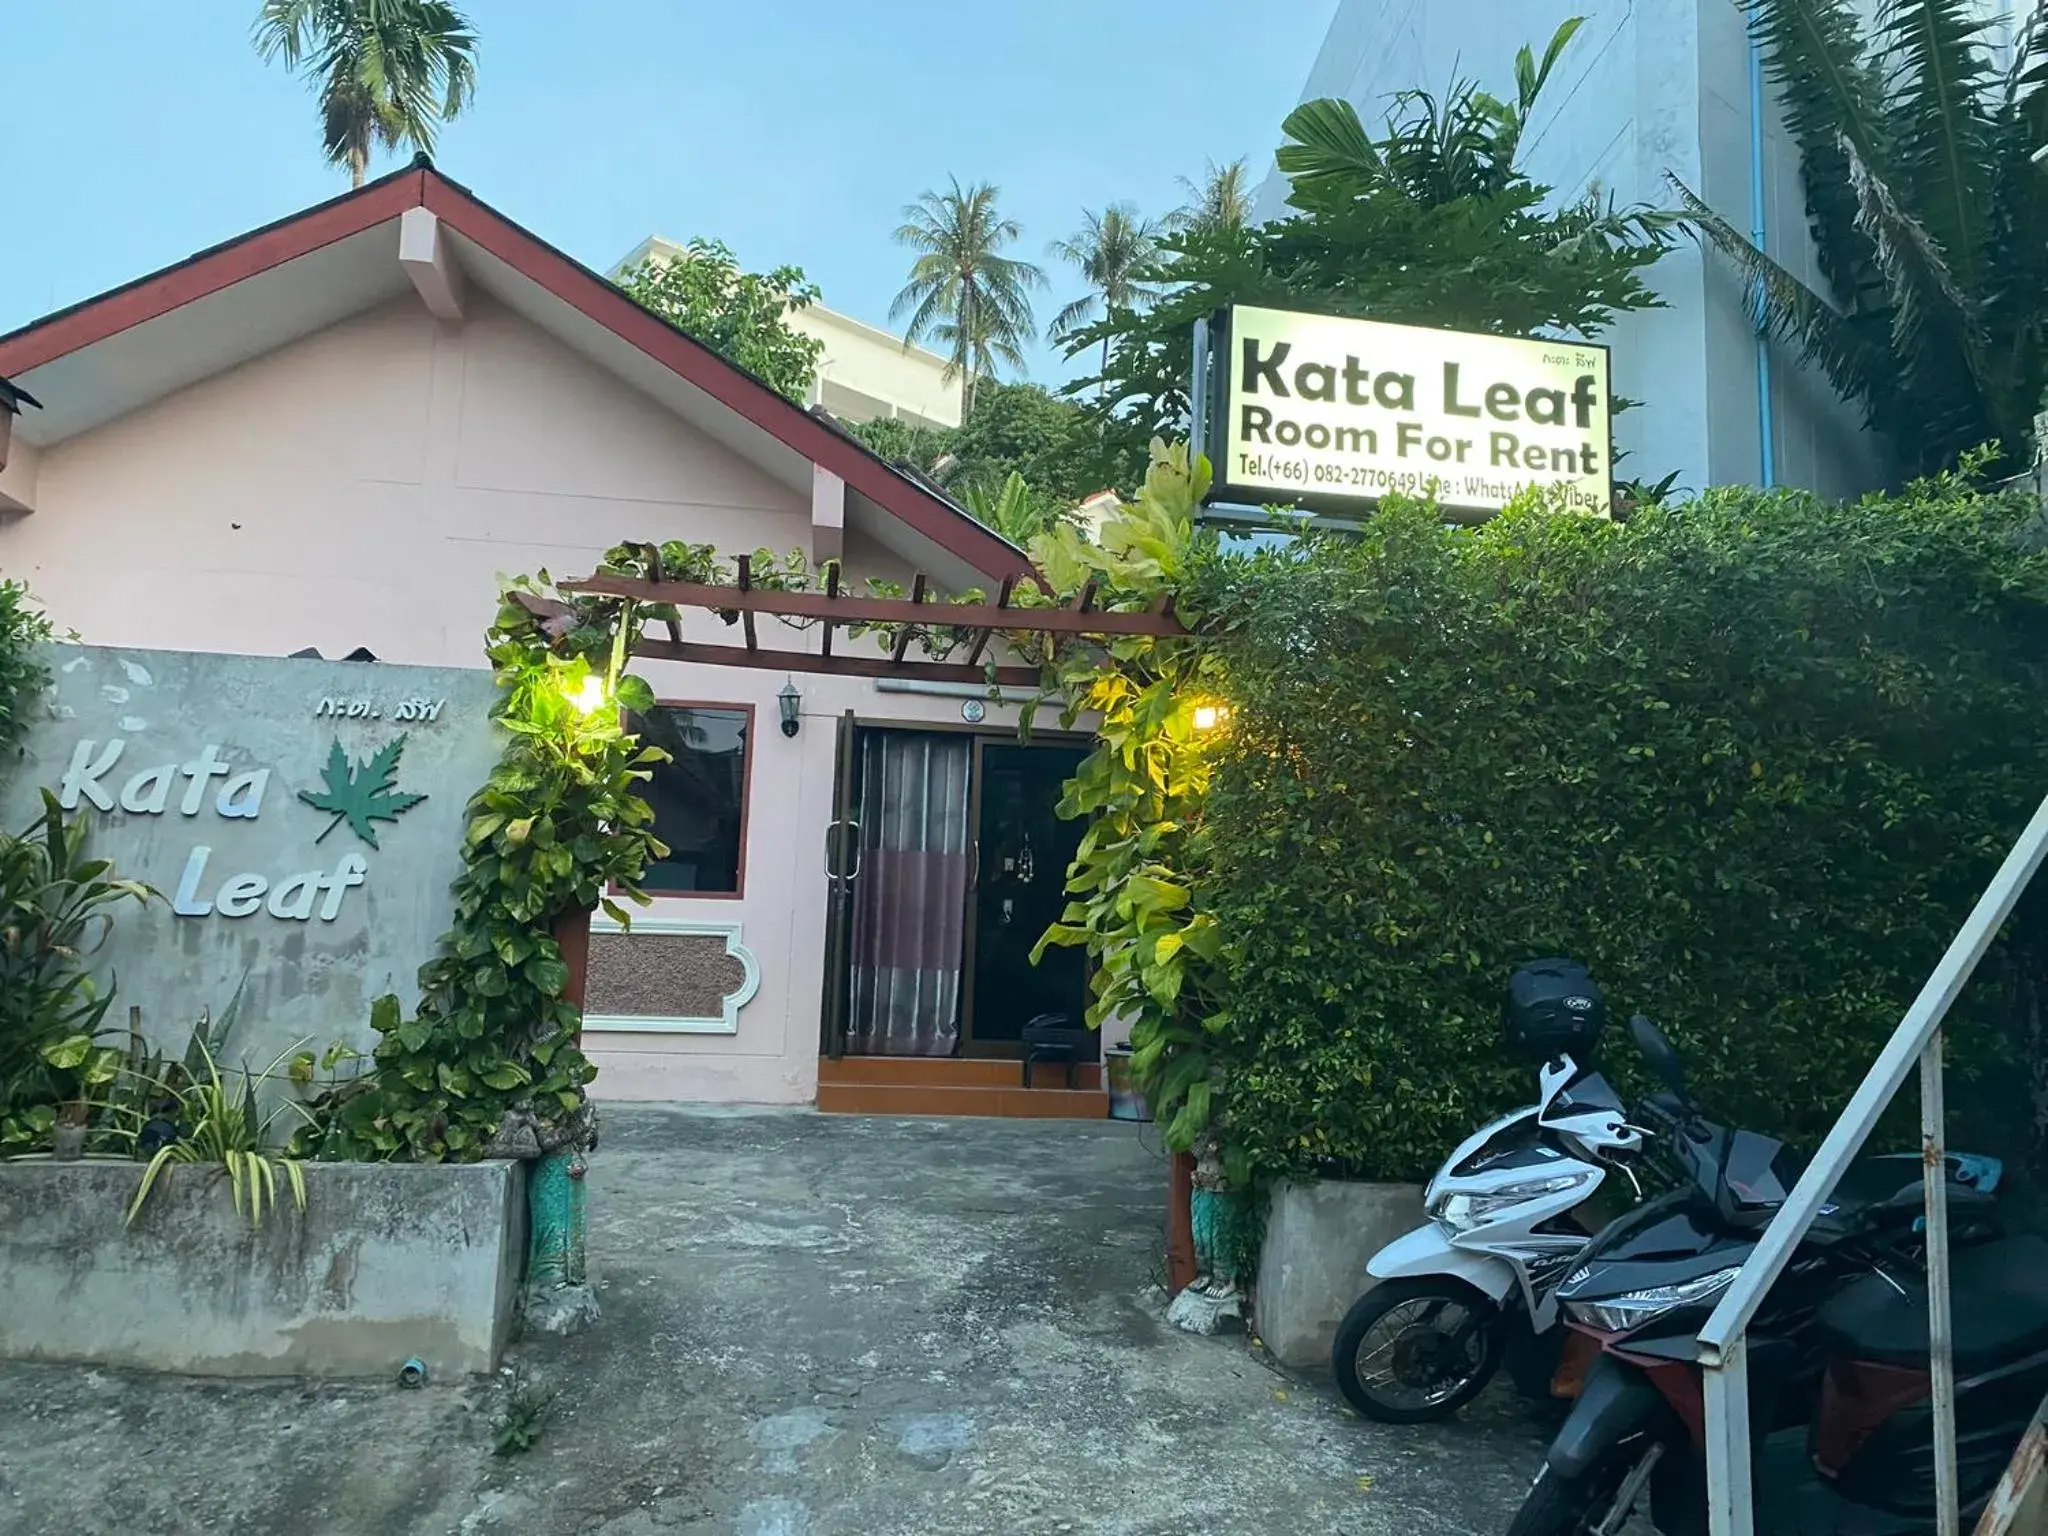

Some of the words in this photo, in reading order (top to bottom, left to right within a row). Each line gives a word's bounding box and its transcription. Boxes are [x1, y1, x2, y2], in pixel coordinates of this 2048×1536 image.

[1242, 337, 1415, 412] Kata
[1443, 361, 1597, 429] Leaf
[1240, 404, 1377, 455] Room
[1397, 421, 1473, 463] For
[1490, 431, 1599, 475] Rent
[1314, 464, 1416, 493] 082-2770649
[60, 738, 271, 820] Kata
[173, 846, 368, 922] Leaf
